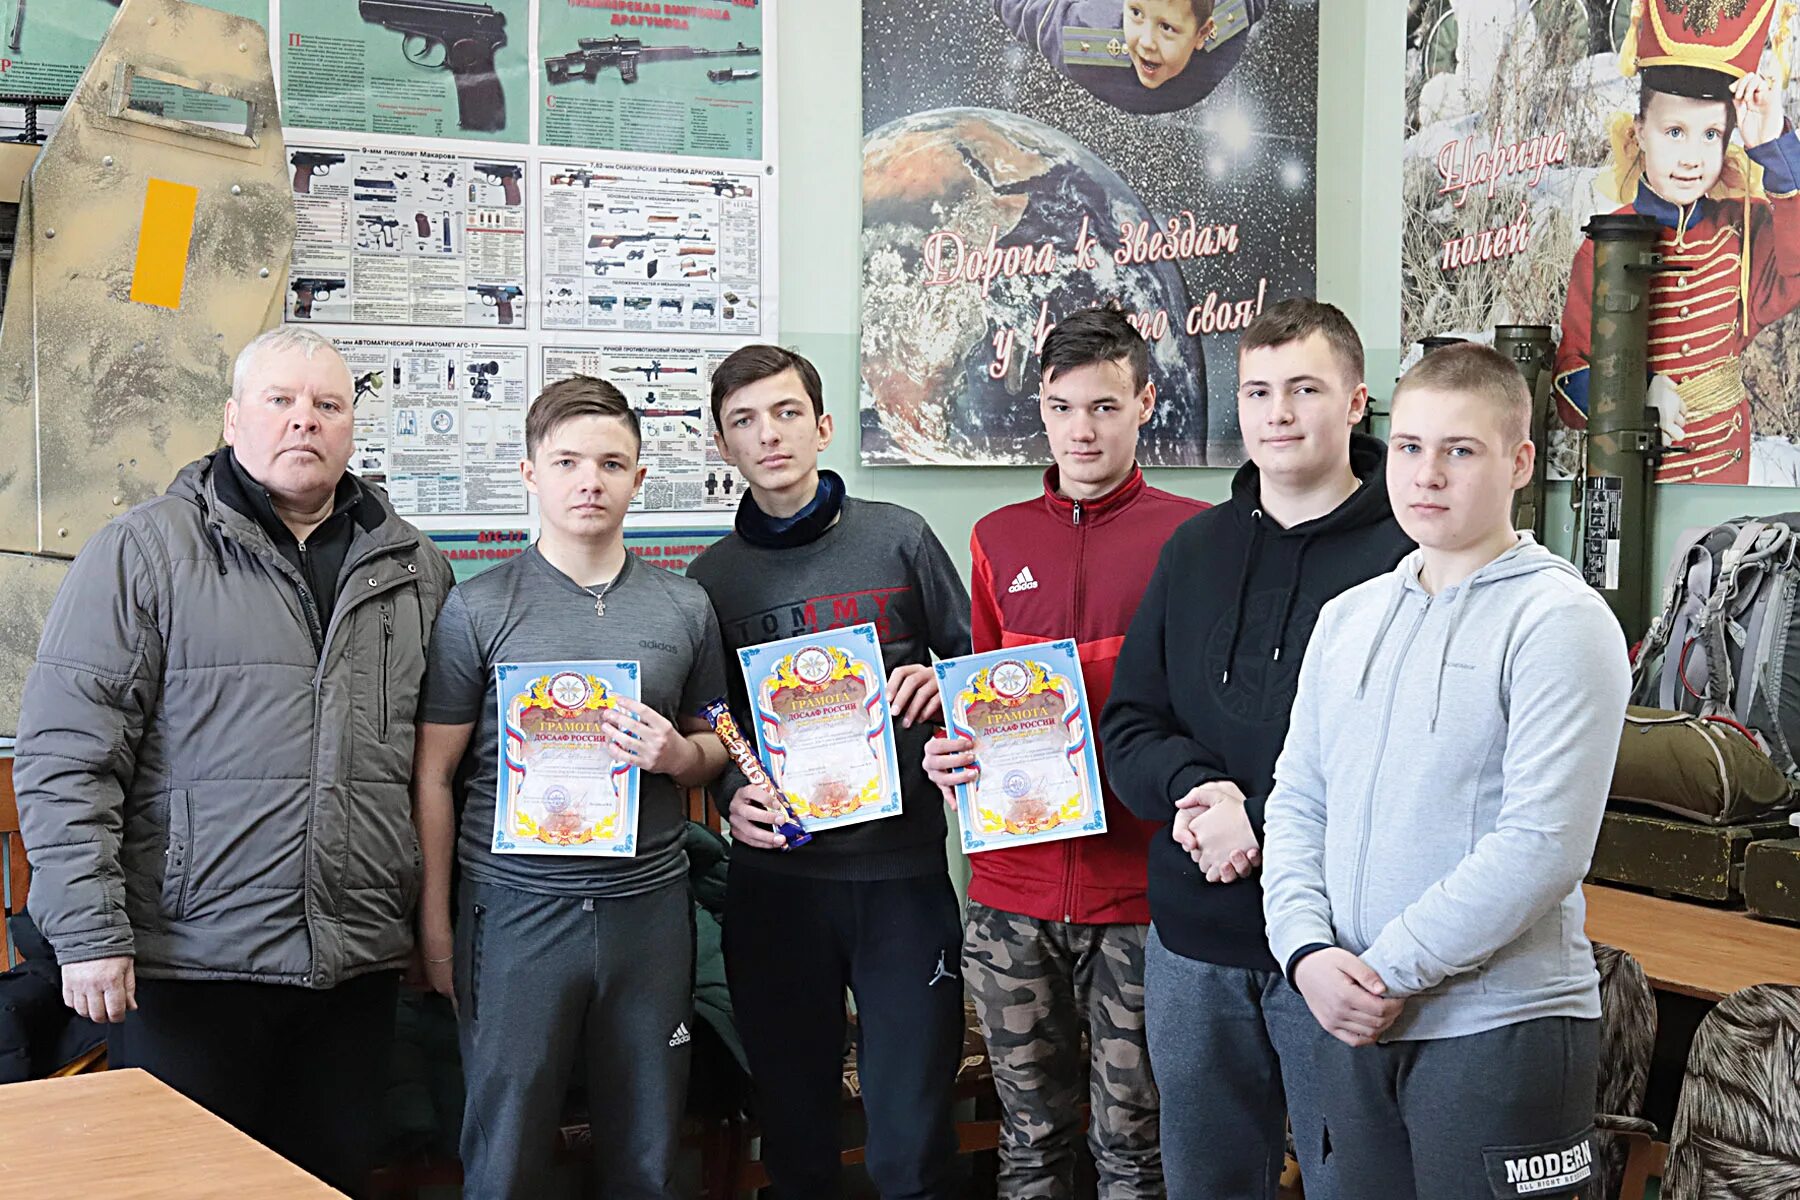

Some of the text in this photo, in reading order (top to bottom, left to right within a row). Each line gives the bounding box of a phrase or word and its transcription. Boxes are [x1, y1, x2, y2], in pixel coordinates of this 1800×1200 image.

[610, 13, 690, 30] ДРАГУНОВА
[361, 146, 456, 160] 9-мм пистолет Макарова
[616, 164, 657, 173] СНАЙПЕРСКАЯ
[658, 167, 690, 175] ВИНТОВКА
[690, 169, 724, 177] ДРАГУНОВА
[1438, 125, 1567, 207] Царица
[1442, 203, 1530, 270] полей
[923, 225, 1057, 298] Дорога
[1074, 216, 1097, 269] к
[989, 325, 1016, 379] у
[1186, 277, 1268, 337] своя!
[354, 339, 414, 347] АВТОМАТИЧЕСКИЙ
[415, 341, 456, 349] ГРАНАТОМЕТ
[457, 342, 479, 350] АГС-17
[477, 530, 524, 543] АГС-17
[1008, 580, 1039, 594] adidas
[732, 592, 891, 643] TOMMY
[638, 639, 678, 655] adidas
[790, 692, 851, 711] ГРАМОТА
[788, 708, 822, 722] ДОСААФ
[823, 703, 857, 716] РОССИИ
[987, 706, 1049, 725] ГРАМОТА
[540, 722, 601, 732] ГРАМОТА
[983, 722, 1019, 736] ДОСААФ
[1020, 717, 1056, 730] РОССИИ
[534, 734, 606, 742] ДОСААФ РОССИИ
[1504, 1140, 1593, 1184] MODERN
[1519, 1178, 1561, 1192] ALL RIGHT
